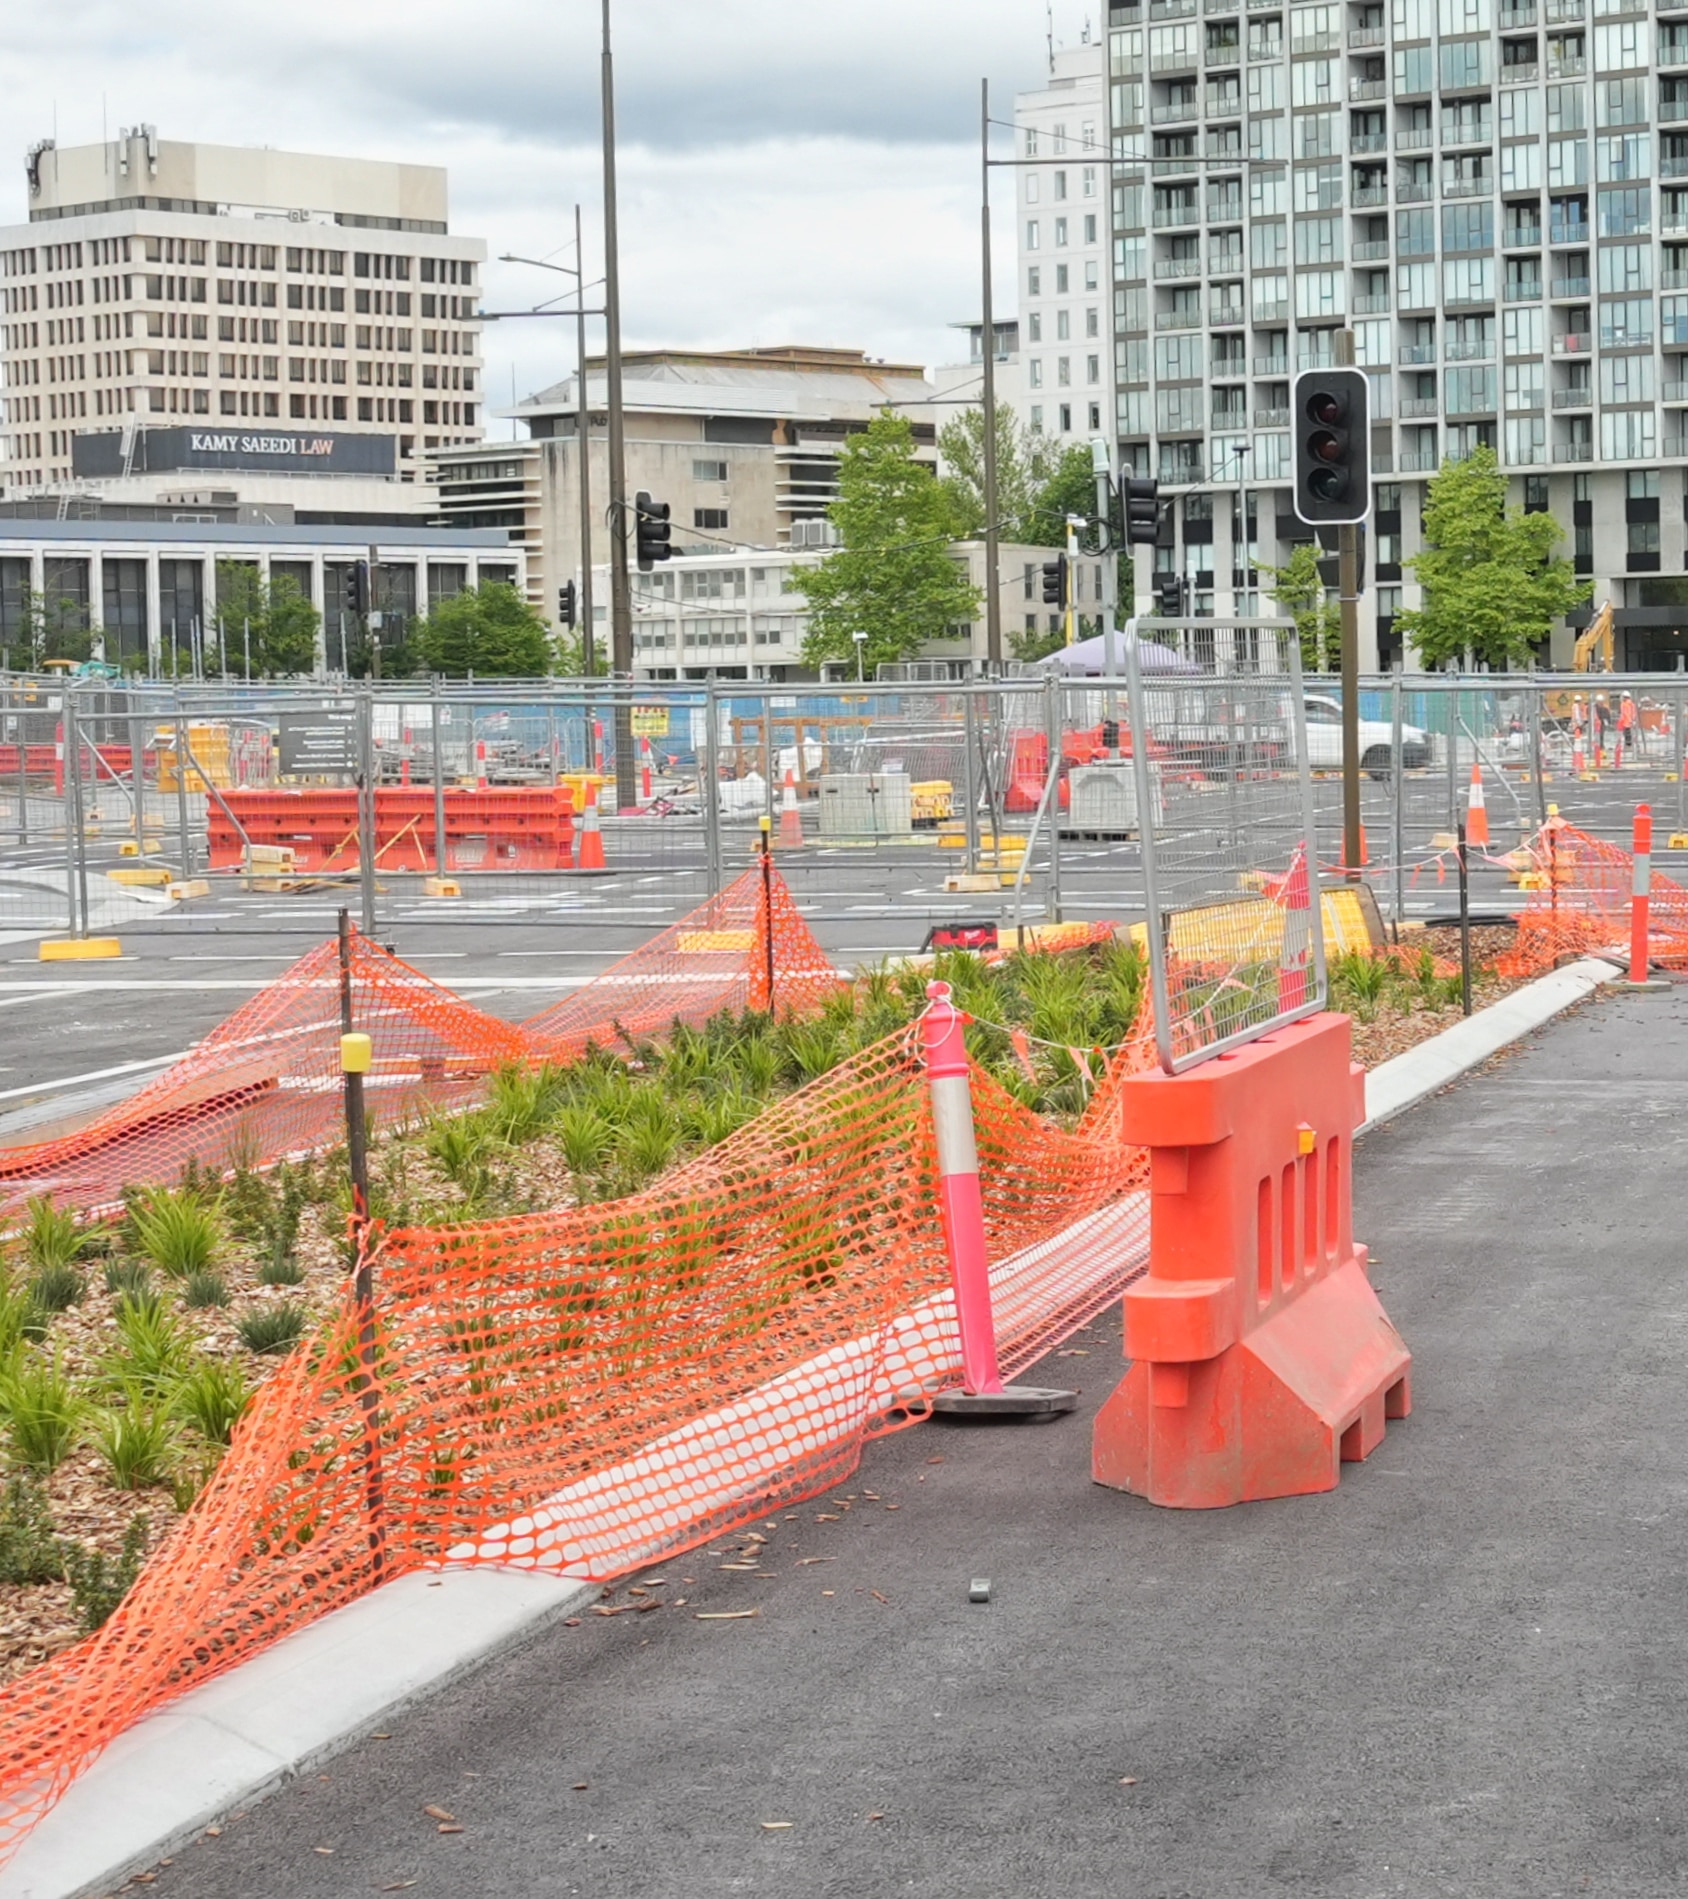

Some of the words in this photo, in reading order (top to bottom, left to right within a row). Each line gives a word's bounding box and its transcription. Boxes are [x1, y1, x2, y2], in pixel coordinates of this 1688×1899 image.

[190, 434, 239, 451] KAMY
[241, 436, 297, 454] SAEEDI
[300, 438, 334, 455] LAW
